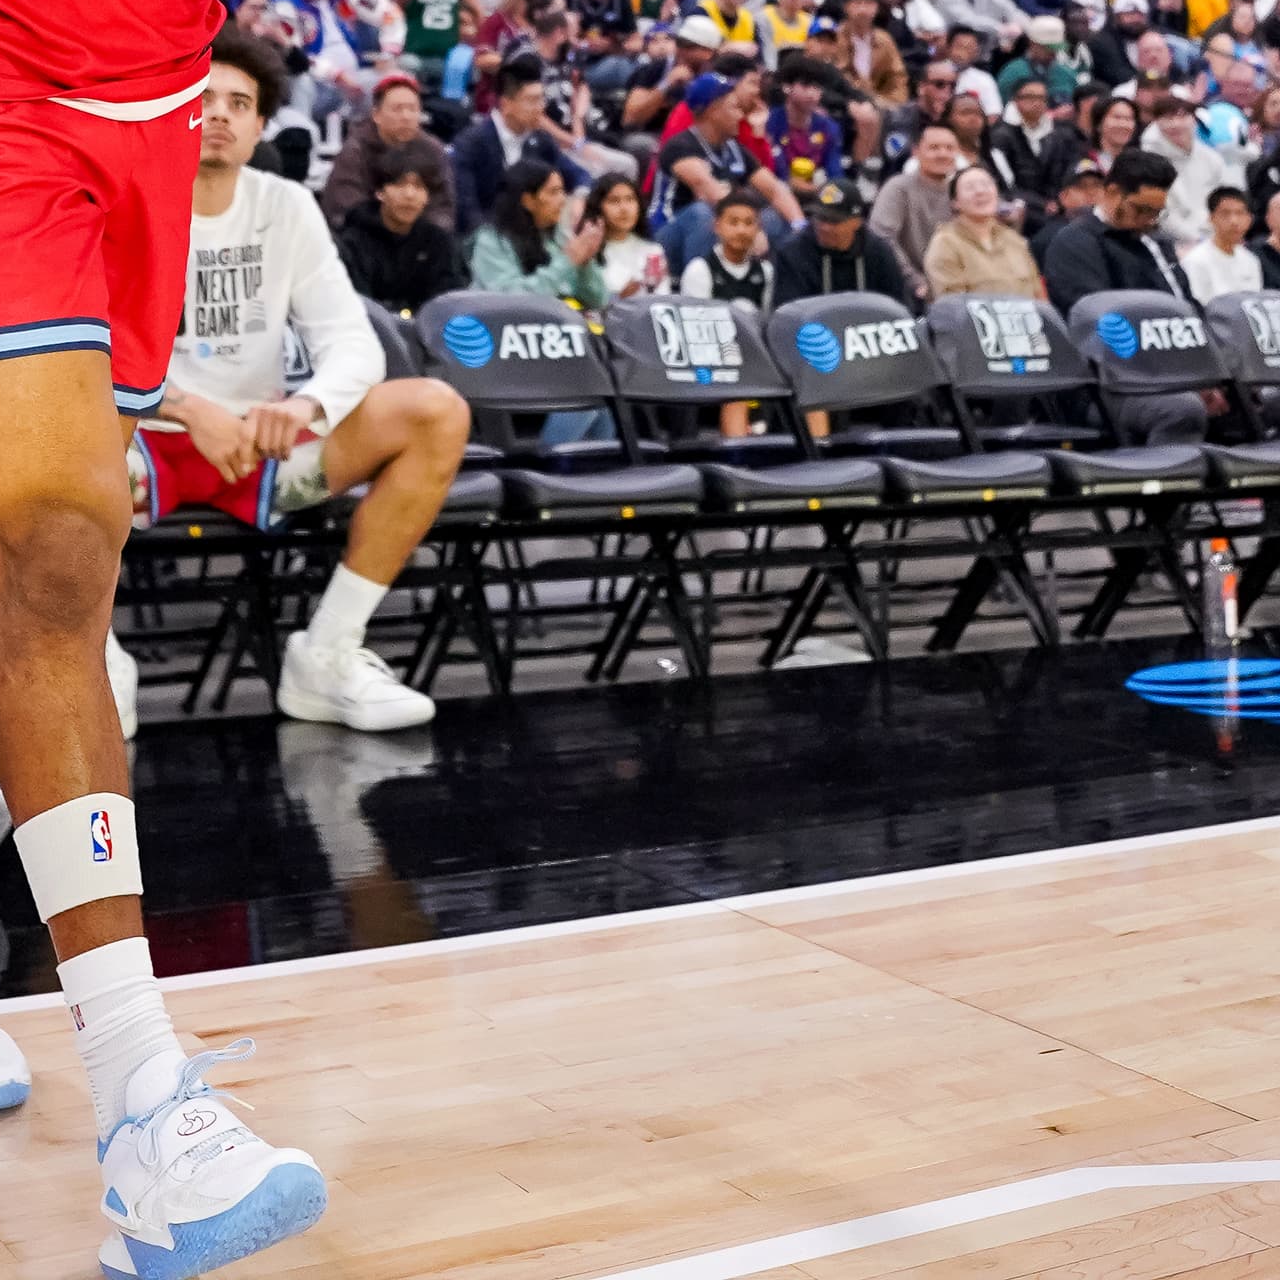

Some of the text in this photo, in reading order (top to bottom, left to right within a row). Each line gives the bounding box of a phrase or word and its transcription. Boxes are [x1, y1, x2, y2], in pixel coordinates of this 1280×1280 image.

[195, 266, 263, 304] NEXT UP
[195, 305, 239, 338] GAME
[844, 318, 919, 361] AT&T
[1140, 316, 1208, 351] AT&T
[499, 323, 586, 360] AT&T
